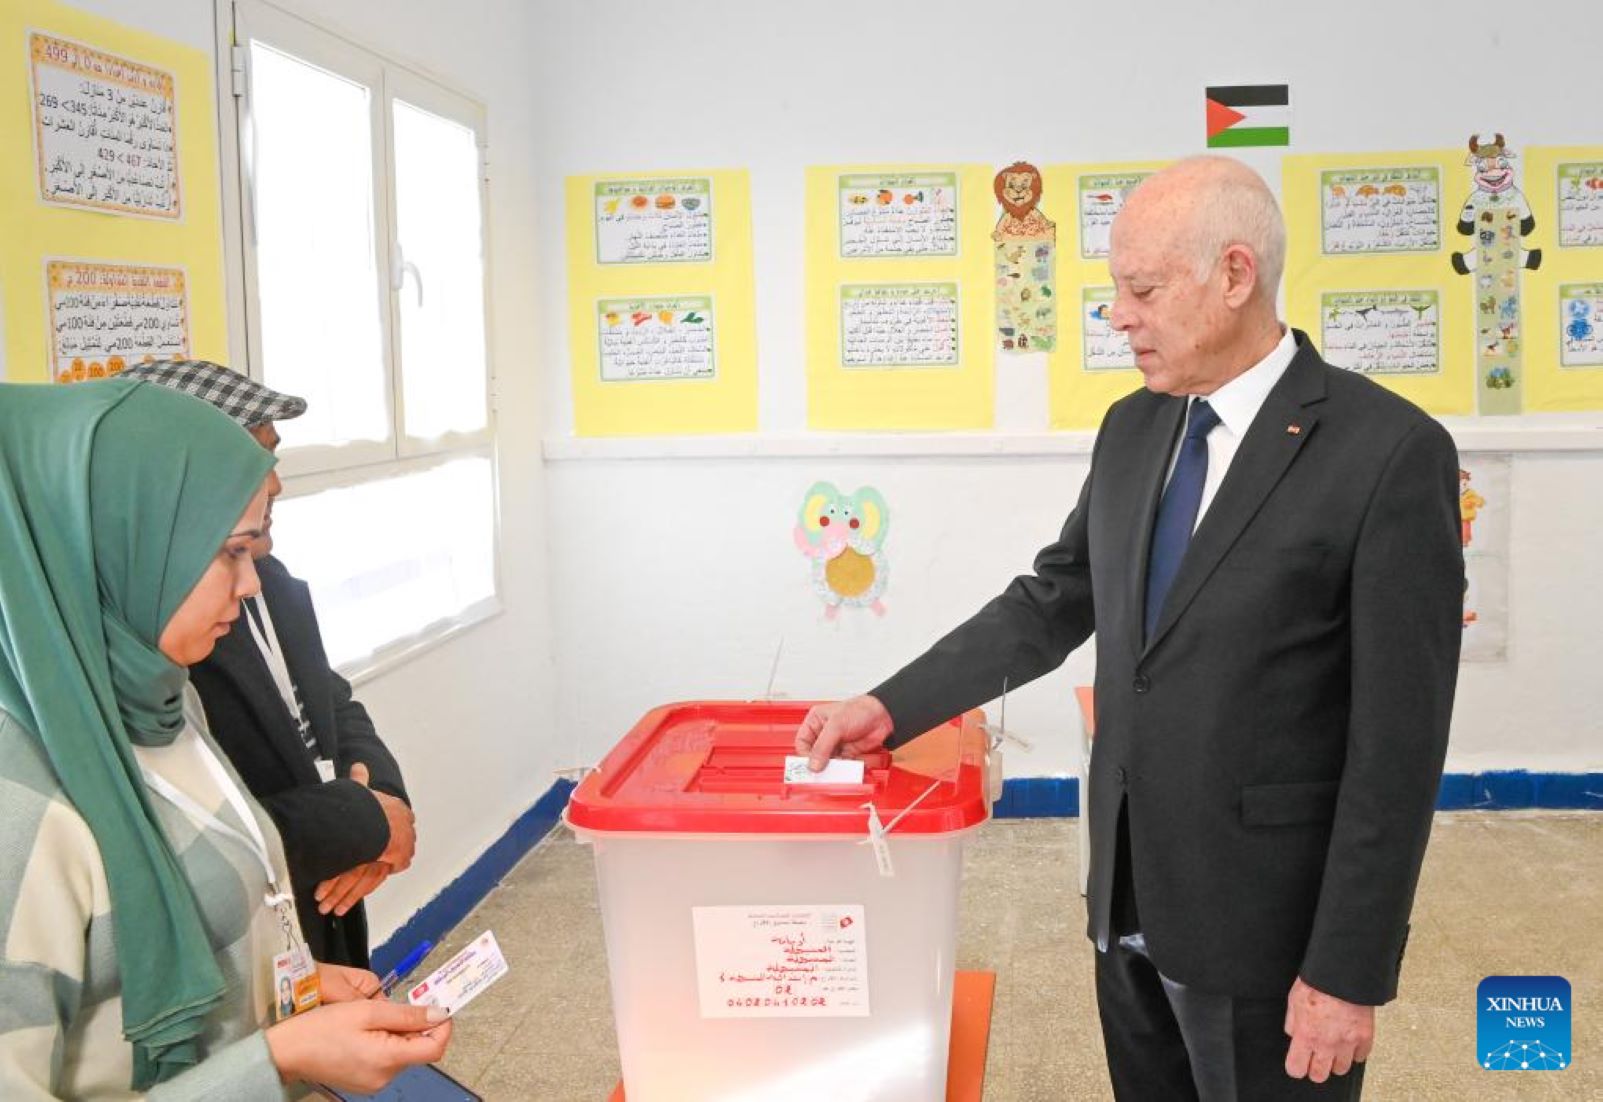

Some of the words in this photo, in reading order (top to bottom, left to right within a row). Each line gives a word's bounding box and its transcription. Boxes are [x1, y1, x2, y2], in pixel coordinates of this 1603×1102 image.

[45, 44, 68, 63] 499
[107, 88, 114, 101] 3
[98, 148, 115, 162] 429
[75, 269, 97, 286] 200
